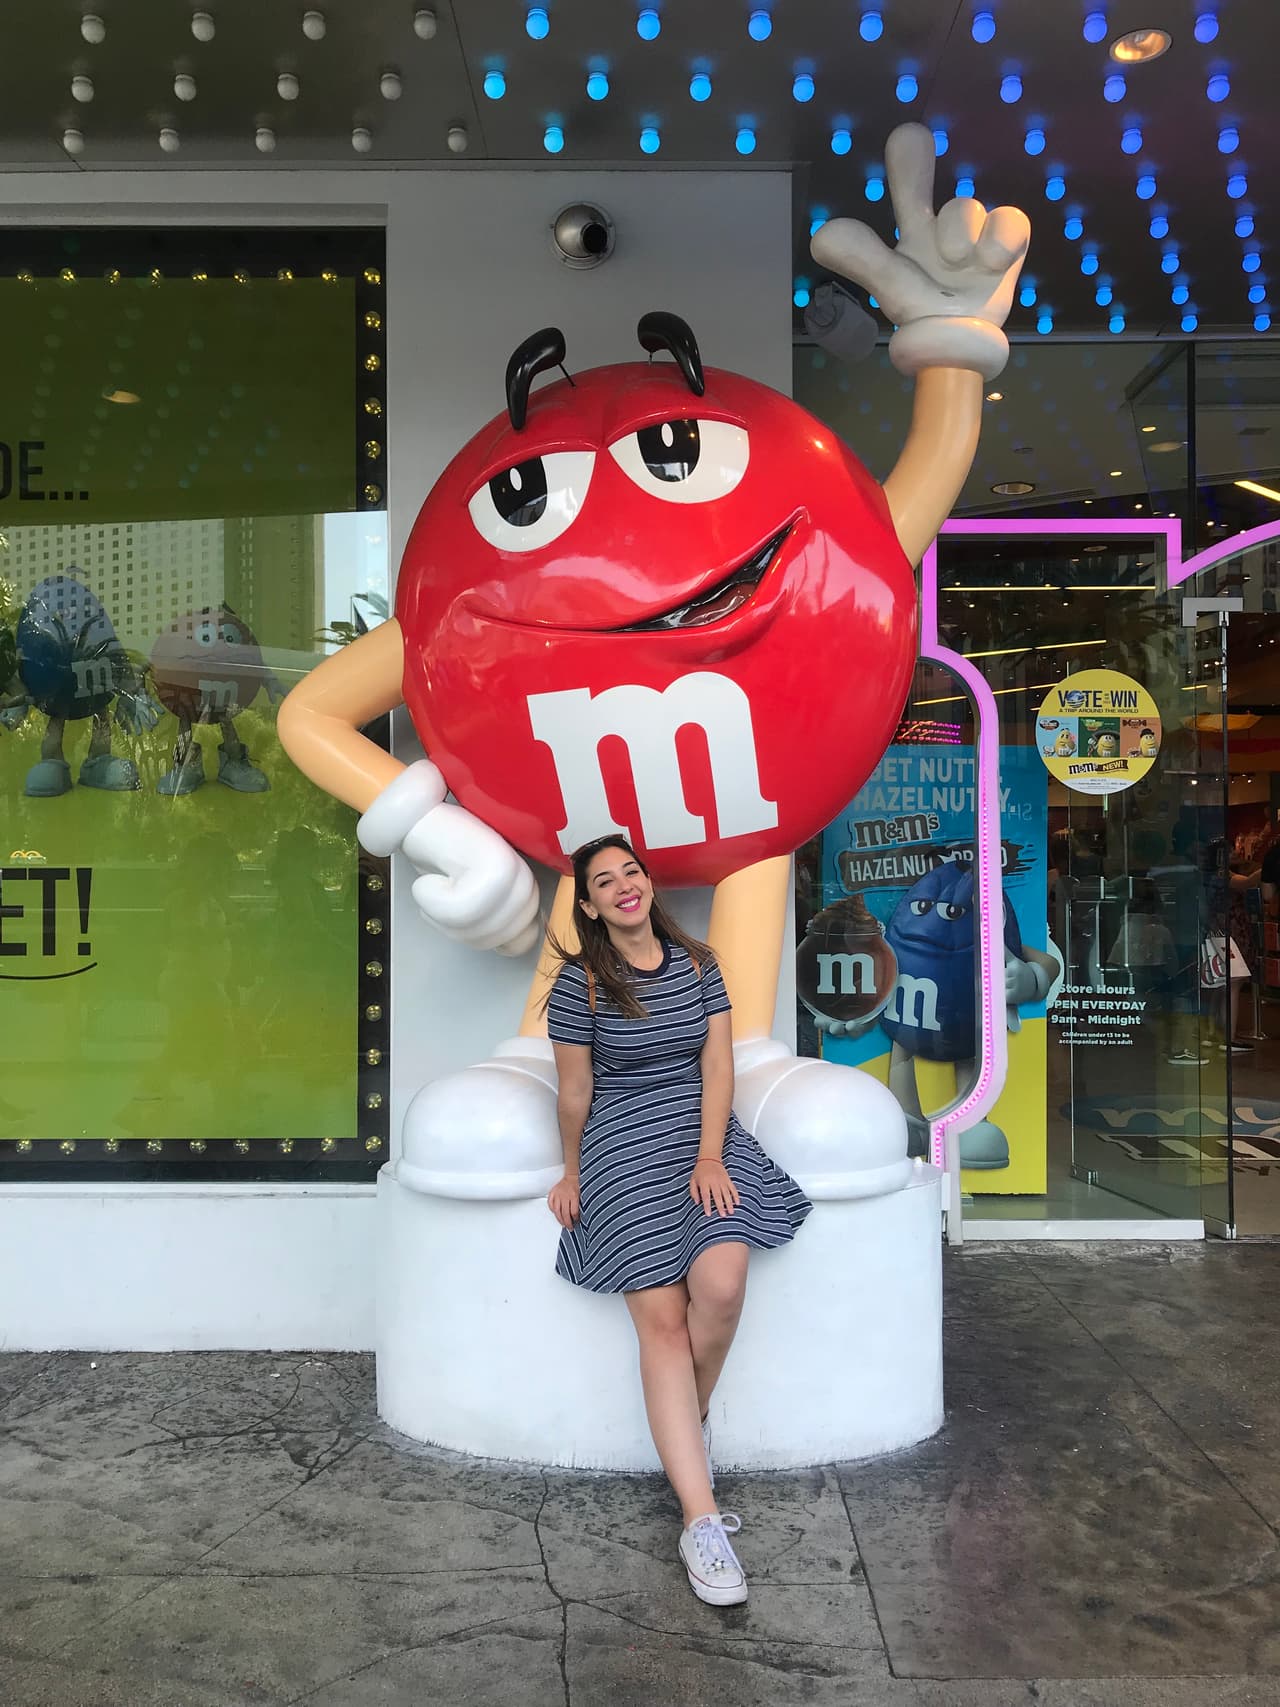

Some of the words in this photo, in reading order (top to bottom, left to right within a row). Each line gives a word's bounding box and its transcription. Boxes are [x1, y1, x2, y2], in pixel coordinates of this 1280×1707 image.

[1058, 690, 1103, 708] VOTE
[1110, 690, 1137, 708] WIN
[527, 671, 778, 855] m
[1102, 761, 1124, 771] NEW!
[1059, 984, 1093, 994] Store
[1096, 985, 1136, 995] Hours
[1082, 1001, 1147, 1010] EVERYDAY
[1051, 1015, 1077, 1024] 9am
[1087, 1015, 1141, 1026] Midnight
